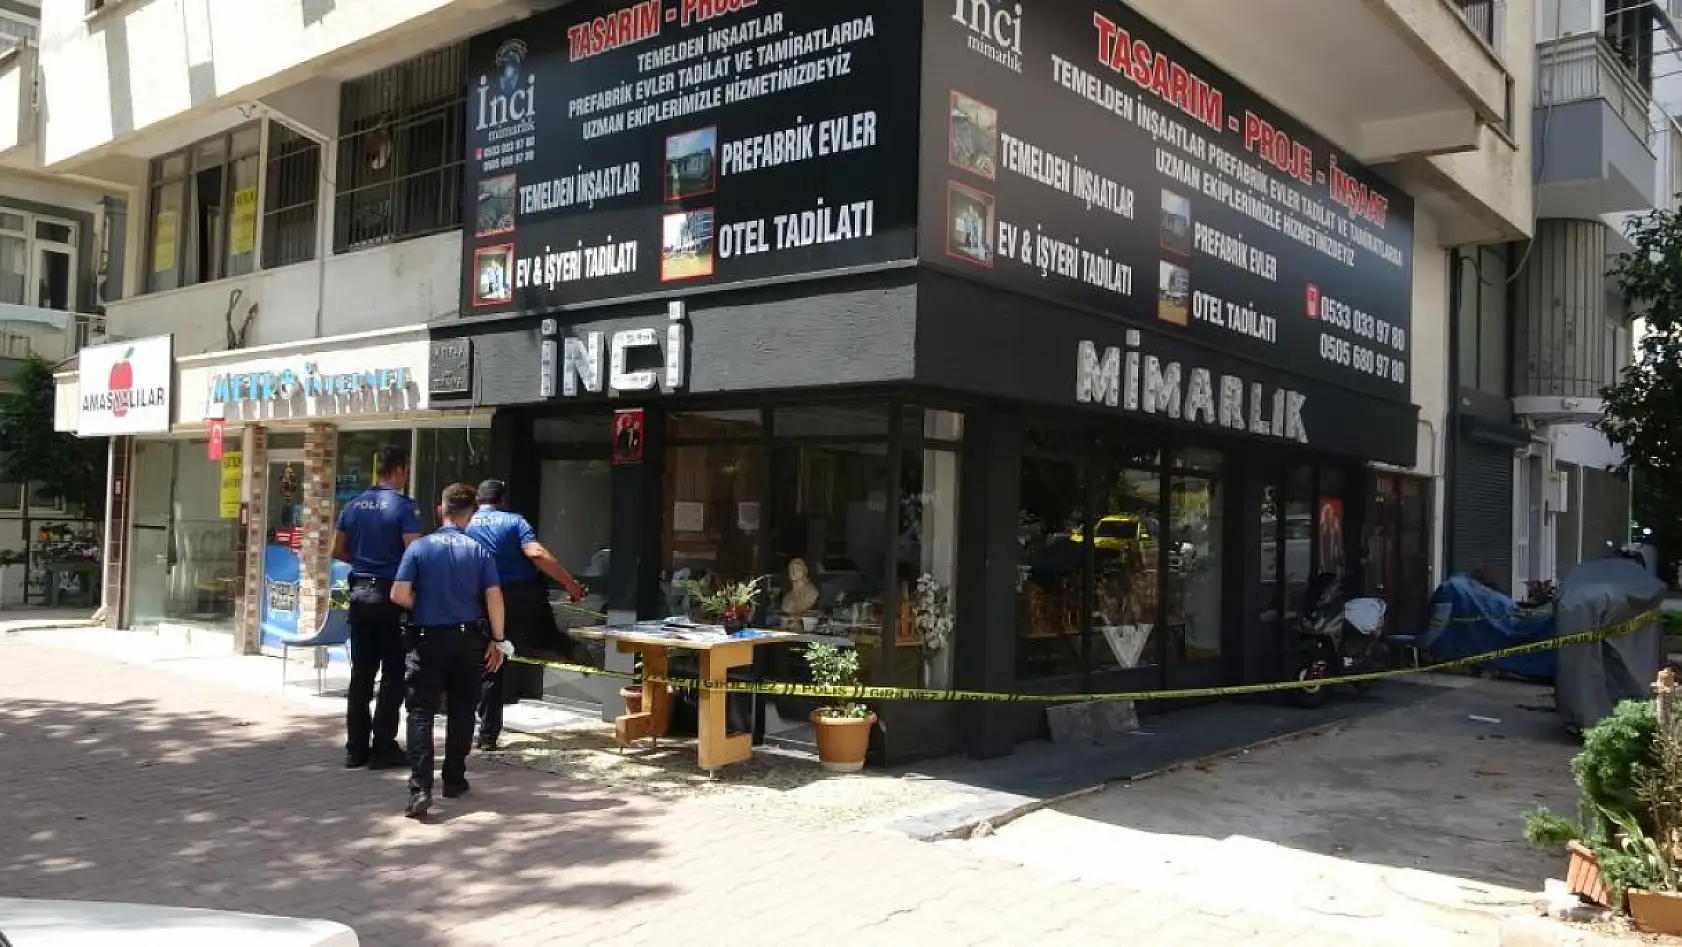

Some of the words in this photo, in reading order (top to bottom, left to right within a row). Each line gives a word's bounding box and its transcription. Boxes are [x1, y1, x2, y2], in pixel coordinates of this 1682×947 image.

[567, 0, 660, 62] TASARIM
[637, 34, 704, 73] TEMELDEN
[708, 12, 783, 53] İNŞAATLAR
[568, 80, 634, 119] PREFABRİK
[635, 73, 674, 100] EVLER
[678, 57, 731, 89] TADİLAT
[735, 50, 753, 73] VE
[757, 15, 874, 66] TAMİRATLARDA
[583, 113, 624, 140] UZMAN
[626, 86, 722, 131] EKİPLERİMİZLE
[725, 47, 851, 105] HİZMETİNİZDEYİZ
[476, 74, 536, 131] İnci
[1093, 11, 1223, 132] TASARIM
[1245, 109, 1313, 186] PROJE
[721, 115, 814, 176] PREFABRİK
[818, 110, 877, 156] EVLER
[1050, 53, 1133, 122] TEMELDEN
[1137, 94, 1206, 160] İNŞAATLAR
[1208, 142, 1268, 197] PREFABRİK
[1270, 176, 1300, 213] EVLER
[520, 174, 574, 215] TEMELDEN
[576, 161, 640, 209] İNŞAATLAR
[1000, 132, 1070, 193] TEMELDEN
[1072, 153, 1135, 221] İNŞAATLAR
[1155, 147, 1200, 190] UZMAN
[1203, 171, 1281, 231] EKİPLERİMİZLE
[719, 218, 769, 259] OTEL
[773, 196, 874, 250] TADİLATI
[998, 220, 1018, 259] EV
[1021, 228, 1032, 265] &
[1036, 223, 1078, 279] İŞYERİ
[1082, 247, 1132, 297] TADİLATI
[1194, 221, 1248, 271] PREFABRİK
[1250, 247, 1277, 282] EVLER
[516, 257, 532, 288] EV
[533, 256, 542, 286] &
[544, 239, 581, 291] İŞYERİ
[585, 235, 637, 279] TADİLATI
[1192, 289, 1225, 327] OTEL
[1226, 301, 1277, 344] TADİLATI
[1321, 296, 1351, 330] 0533
[1353, 309, 1375, 339] 033
[1376, 319, 1390, 345] 97
[1391, 326, 1405, 352] 80
[1076, 329, 1308, 443] MİMARLIK
[1320, 333, 1351, 367] 0505
[1353, 345, 1374, 375] 680
[1376, 353, 1390, 378] 97
[82, 387, 165, 412] AMASYALILAR
